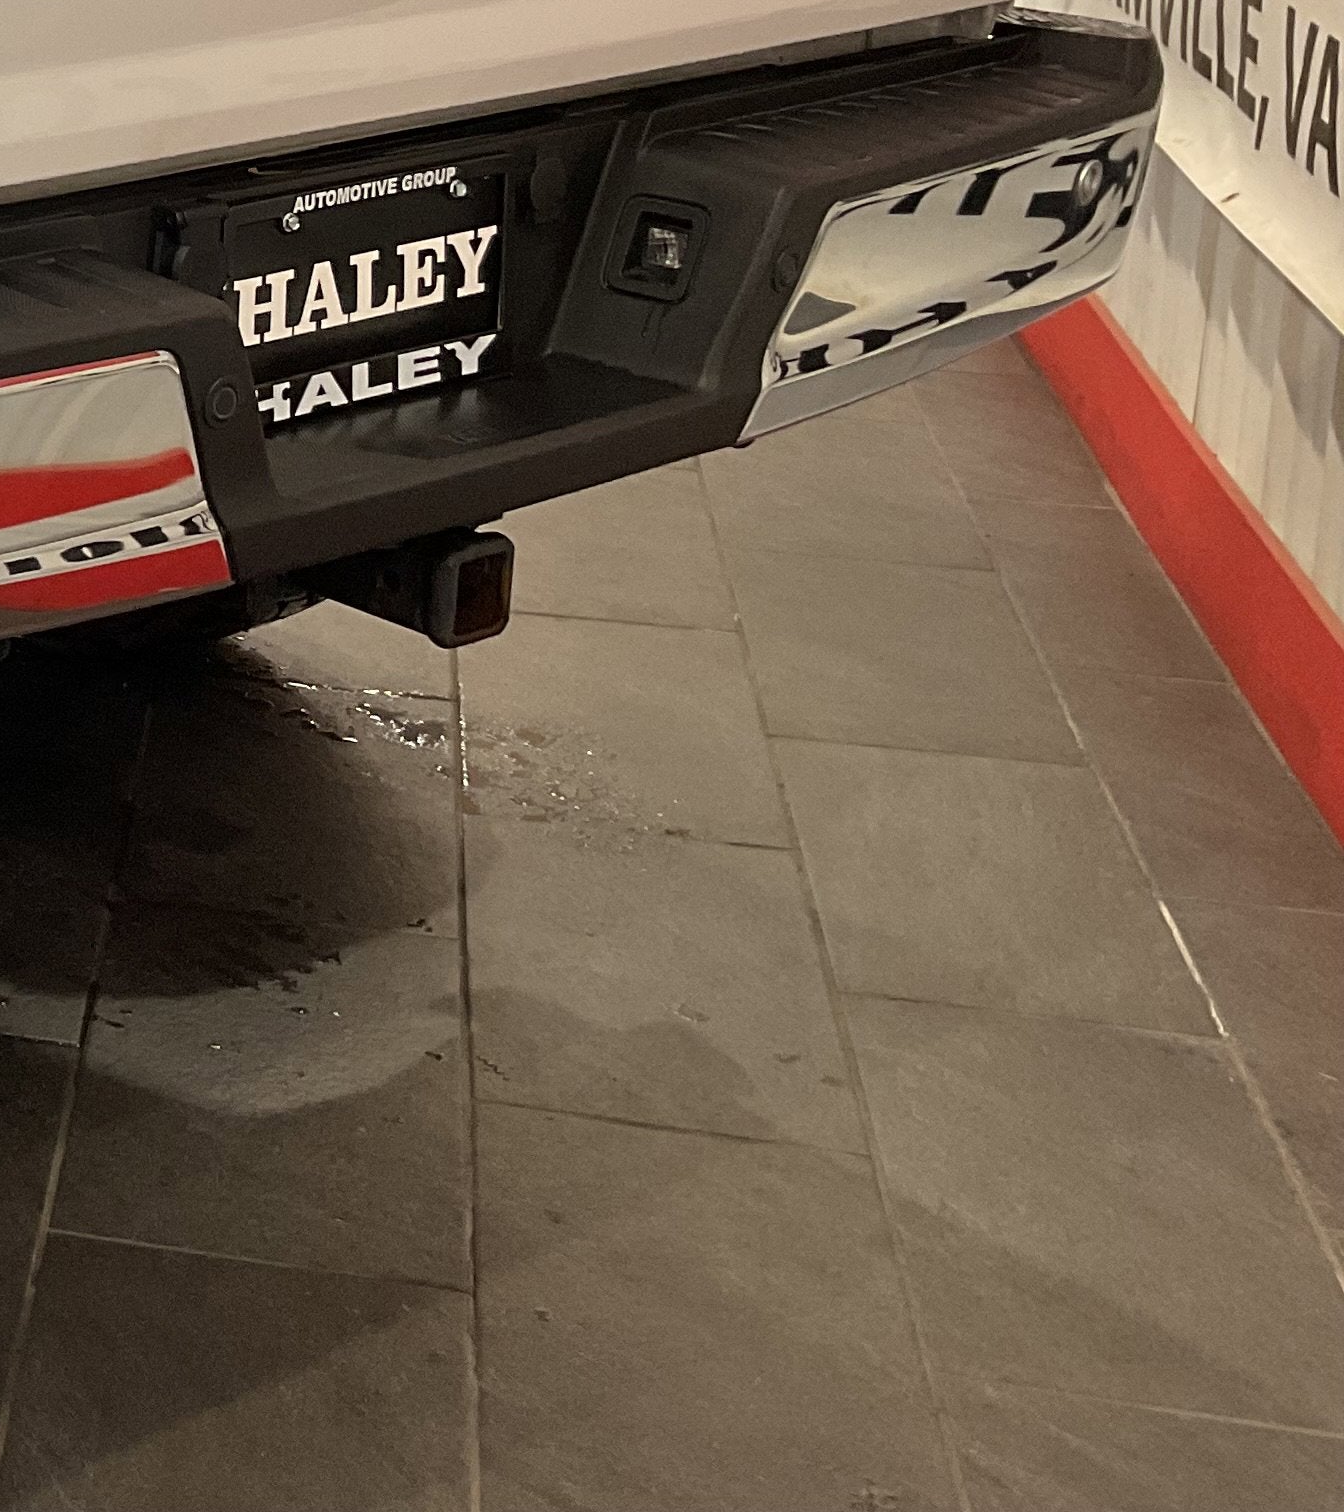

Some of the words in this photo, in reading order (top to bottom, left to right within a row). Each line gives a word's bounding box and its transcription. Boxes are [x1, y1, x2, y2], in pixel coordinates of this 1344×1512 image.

[1285, 5, 1340, 198] VA
[292, 177, 399, 214] AUTOMOTIVE
[401, 166, 457, 192] GROUP
[233, 224, 498, 347] HALEY
[254, 333, 498, 423] HALEY
